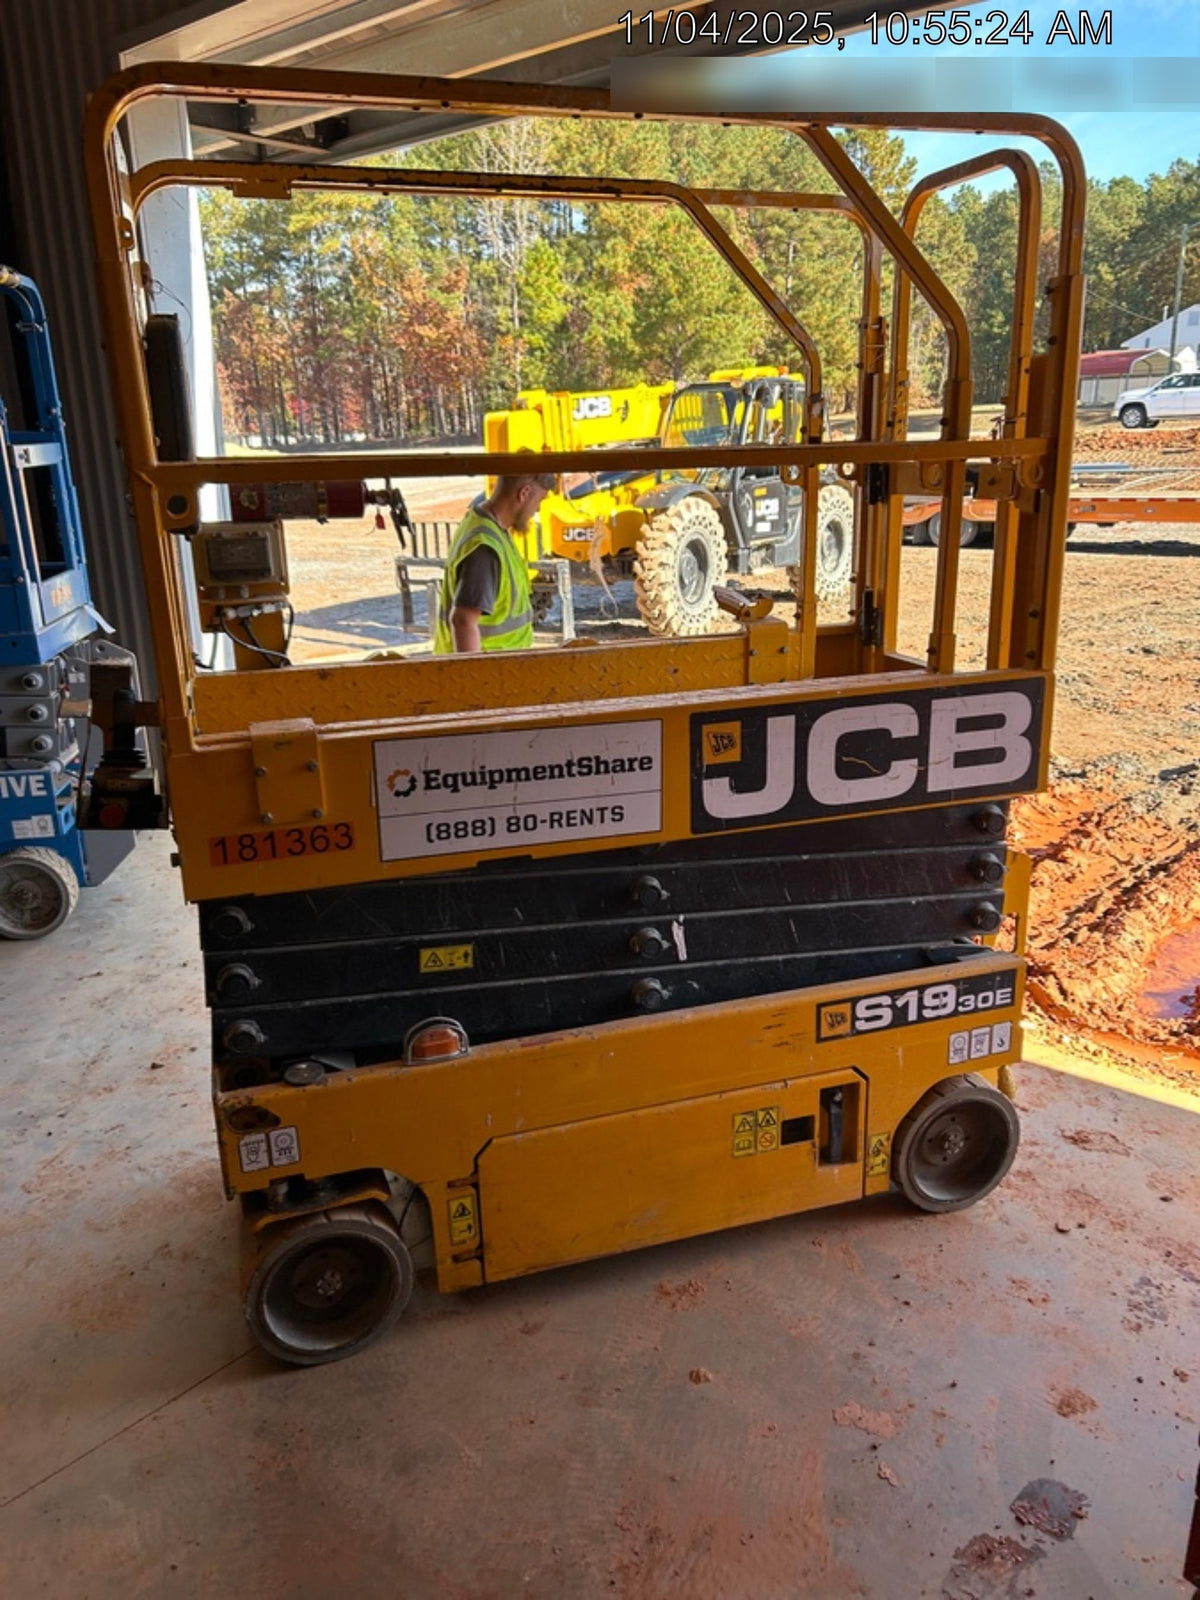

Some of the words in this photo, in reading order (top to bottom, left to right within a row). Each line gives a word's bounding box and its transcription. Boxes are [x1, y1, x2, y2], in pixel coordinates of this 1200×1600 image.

[573, 396, 611, 420] JCB
[703, 691, 1032, 819] JCB
[709, 732, 736, 755] JCB
[423, 755, 653, 793] EquipmentShare
[213, 822, 354, 865] 181363
[425, 817, 496, 844] (888)
[505, 805, 625, 834] 80-RENTS
